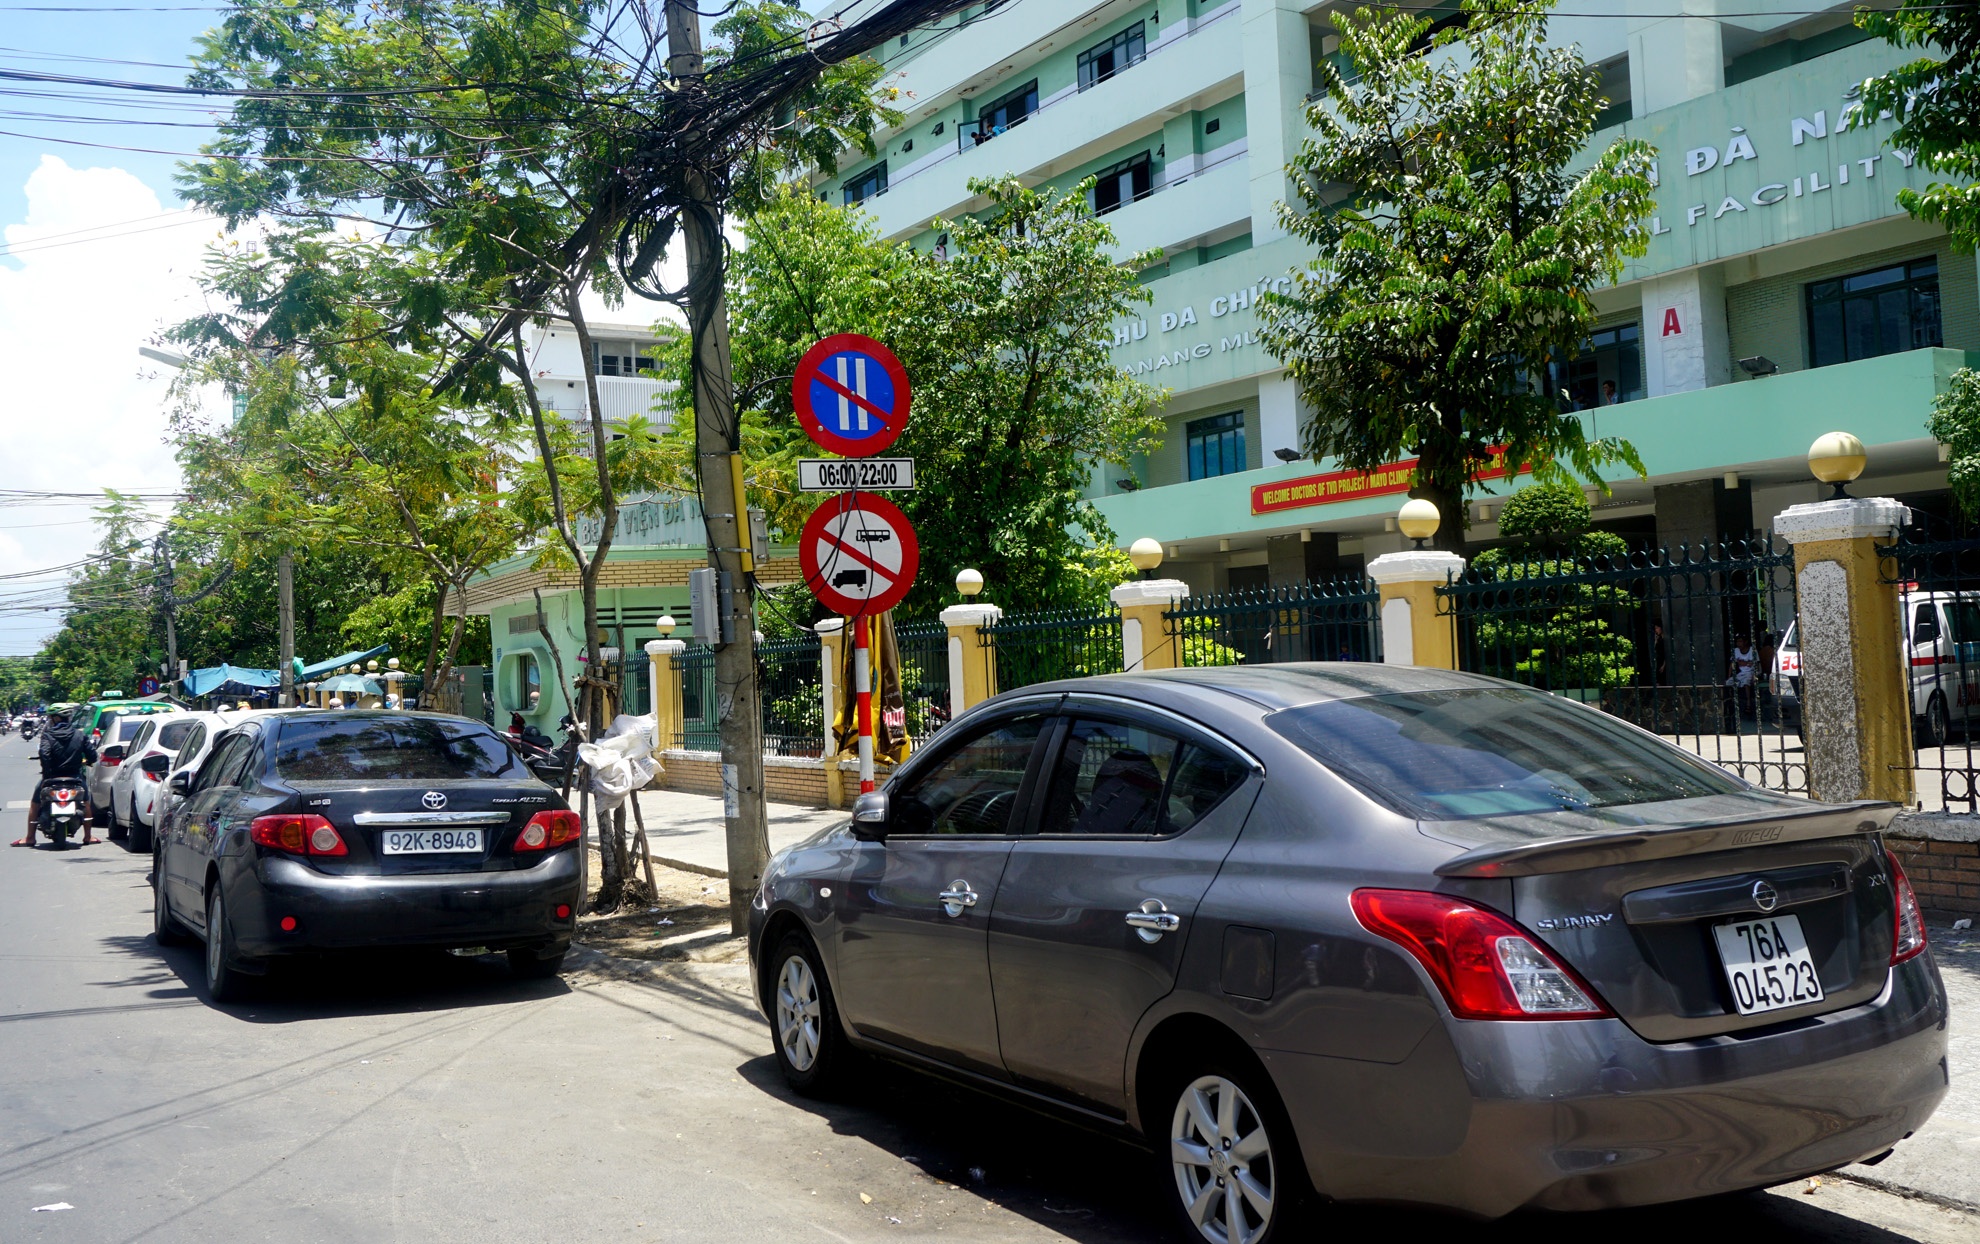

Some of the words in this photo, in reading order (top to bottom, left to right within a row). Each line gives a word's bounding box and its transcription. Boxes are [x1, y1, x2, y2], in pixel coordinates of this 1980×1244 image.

[1161, 306, 1198, 333] ĐA
[1685, 126, 1758, 177] ĐÀ
[1116, 343, 1212, 377] ANANG
[1687, 148, 1919, 226] FACILITY
[1663, 308, 1681, 337] A
[1263, 487, 1290, 505] WELCOME
[1291, 484, 1317, 500] DOCTORS
[1318, 484, 1325, 496] OF
[1338, 476, 1365, 493] PROJECT
[1370, 472, 1387, 488] MAYO
[390, 832, 477, 851] 92K-8948
[1537, 913, 1613, 933] SUNNY
[1736, 921, 1790, 963] 76A
[1734, 961, 1818, 1010] 045.23
